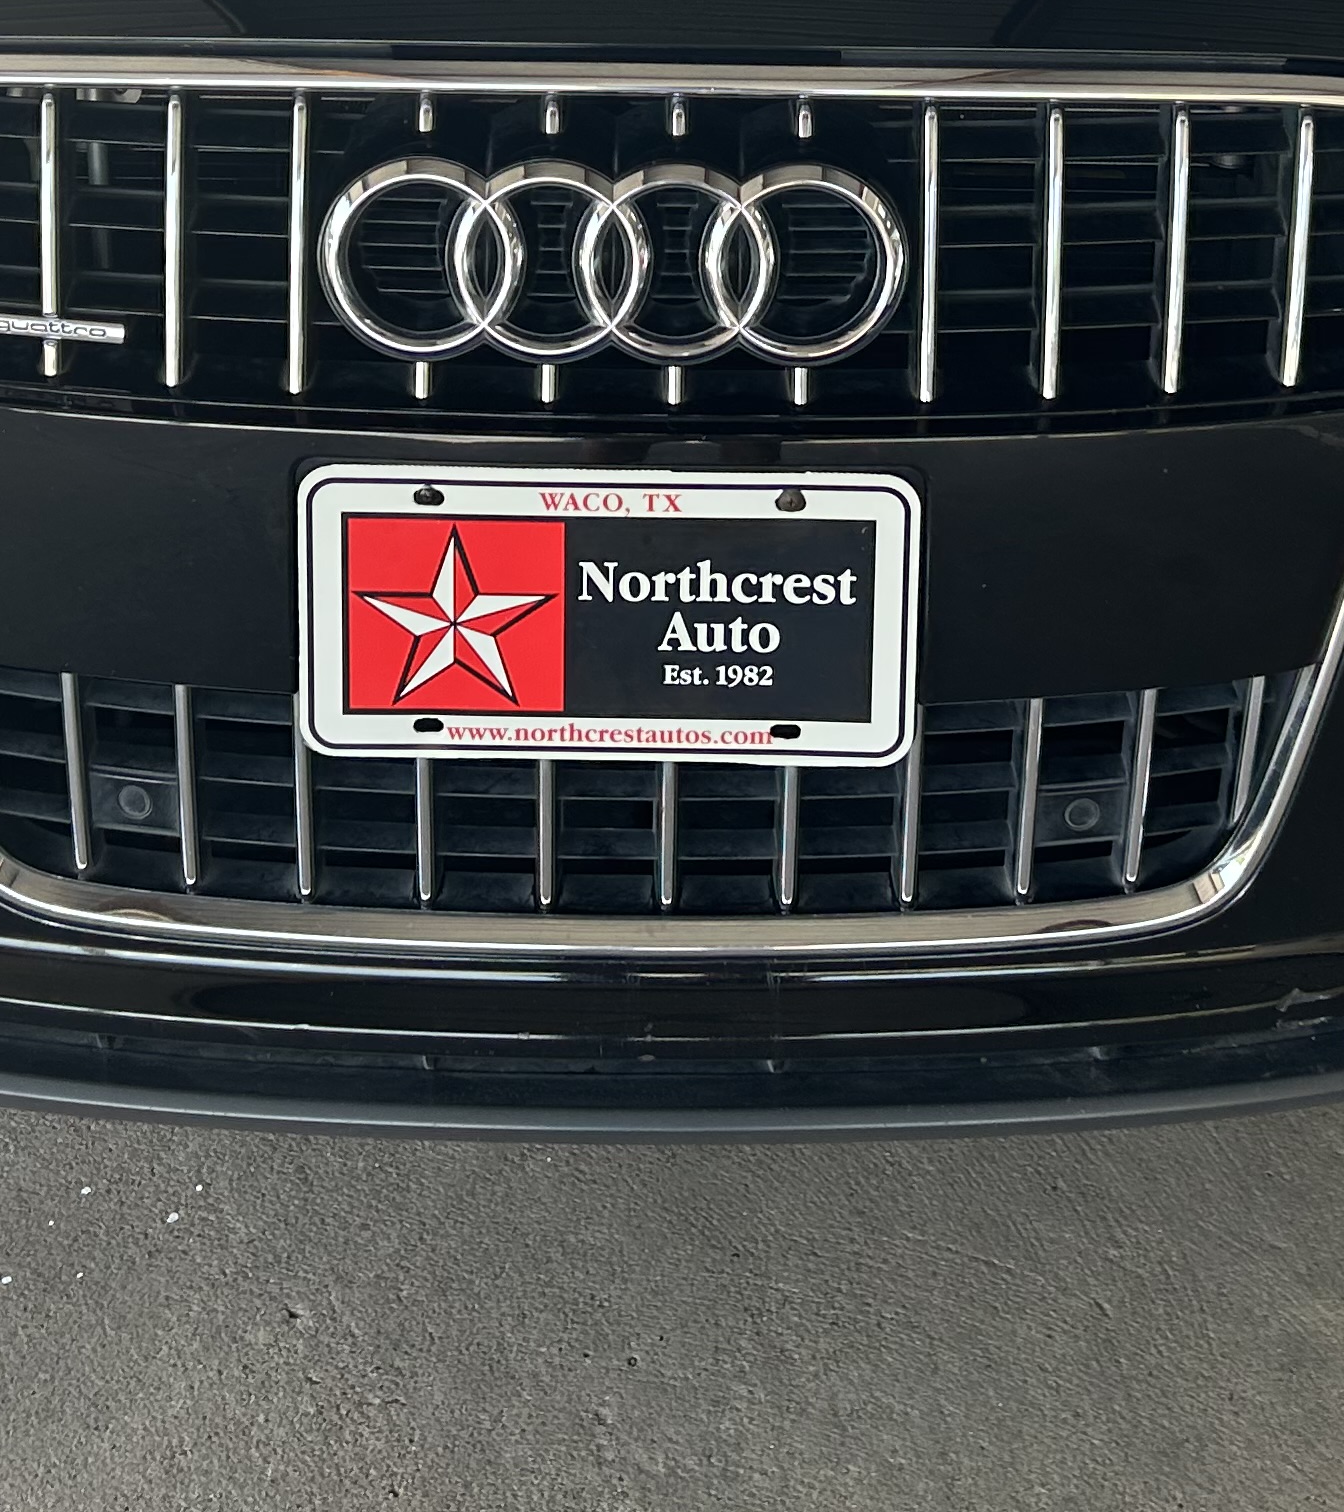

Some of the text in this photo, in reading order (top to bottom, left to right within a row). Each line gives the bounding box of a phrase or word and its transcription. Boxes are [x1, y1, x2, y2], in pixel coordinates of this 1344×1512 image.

[538, 491, 682, 516] WACO, TX
[578, 559, 857, 605] Northcrest
[657, 611, 781, 654] Auto
[662, 665, 773, 687] Est. 1982
[446, 722, 774, 746] www.northcrestautos.com
